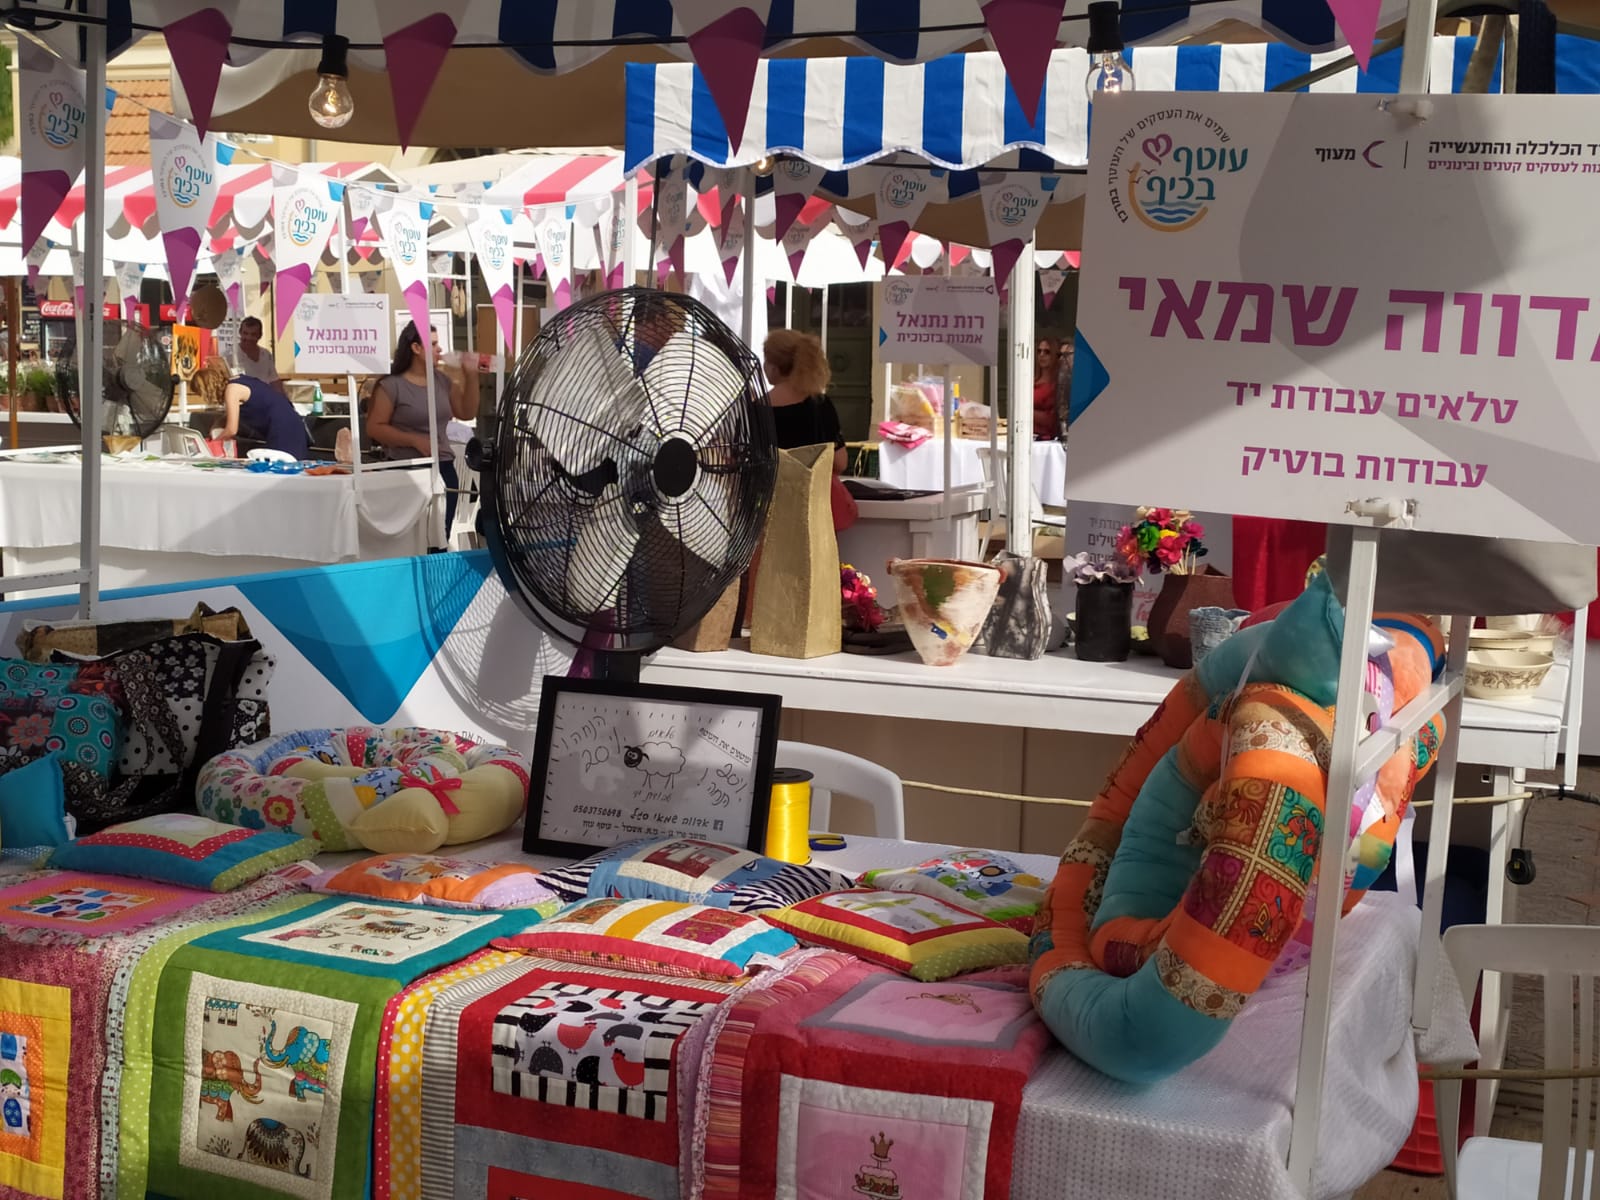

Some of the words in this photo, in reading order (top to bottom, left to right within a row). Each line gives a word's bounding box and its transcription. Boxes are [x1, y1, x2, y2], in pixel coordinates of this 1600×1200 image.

[62, 103, 86, 124] וטף
[1136, 108, 1183, 130] העסקים
[1185, 109, 1203, 124] את
[48, 114, 78, 139] בכיף
[1204, 117, 1231, 143] שמים
[1119, 128, 1136, 144] של
[1314, 145, 1357, 163] מעוף
[1428, 140, 1511, 155] והתעשייה
[1515, 140, 1582, 156] הכלכלה
[1108, 145, 1125, 185] העוטף
[1172, 146, 1249, 177] עוטף
[1428, 160, 1480, 171] ובינוניים
[1483, 161, 1522, 173] קטנים
[1526, 161, 1578, 175] לעסקים
[185, 164, 213, 185] עוטף
[174, 176, 200, 197] בכיף
[891, 187, 915, 201] בכיף
[902, 179, 927, 193] עוטף
[1146, 175, 1216, 206] בכיף
[1012, 196, 1039, 208] עוטף
[1109, 188, 1129, 224] במרכז
[303, 206, 328, 223] עוטף
[1002, 206, 1027, 218] בכיף
[294, 218, 317, 235] בכיף
[402, 227, 421, 241] עוטף
[896, 311, 948, 328] נתנאל
[1118, 276, 1359, 347] שמאי
[954, 315, 984, 329] רות
[1385, 288, 1600, 362] דווה
[306, 326, 348, 341] נתנאל
[352, 328, 377, 341] רות
[897, 332, 944, 343] בזכוכית
[947, 333, 982, 344] אמנות
[308, 344, 345, 355] בזכוכית
[348, 345, 377, 355] אמנות
[1226, 381, 1262, 406] יד
[1271, 383, 1386, 415] עבודת
[1396, 390, 1519, 425] טלאים
[1241, 446, 1346, 478] בוטיק
[1355, 454, 1488, 489] עבודות
